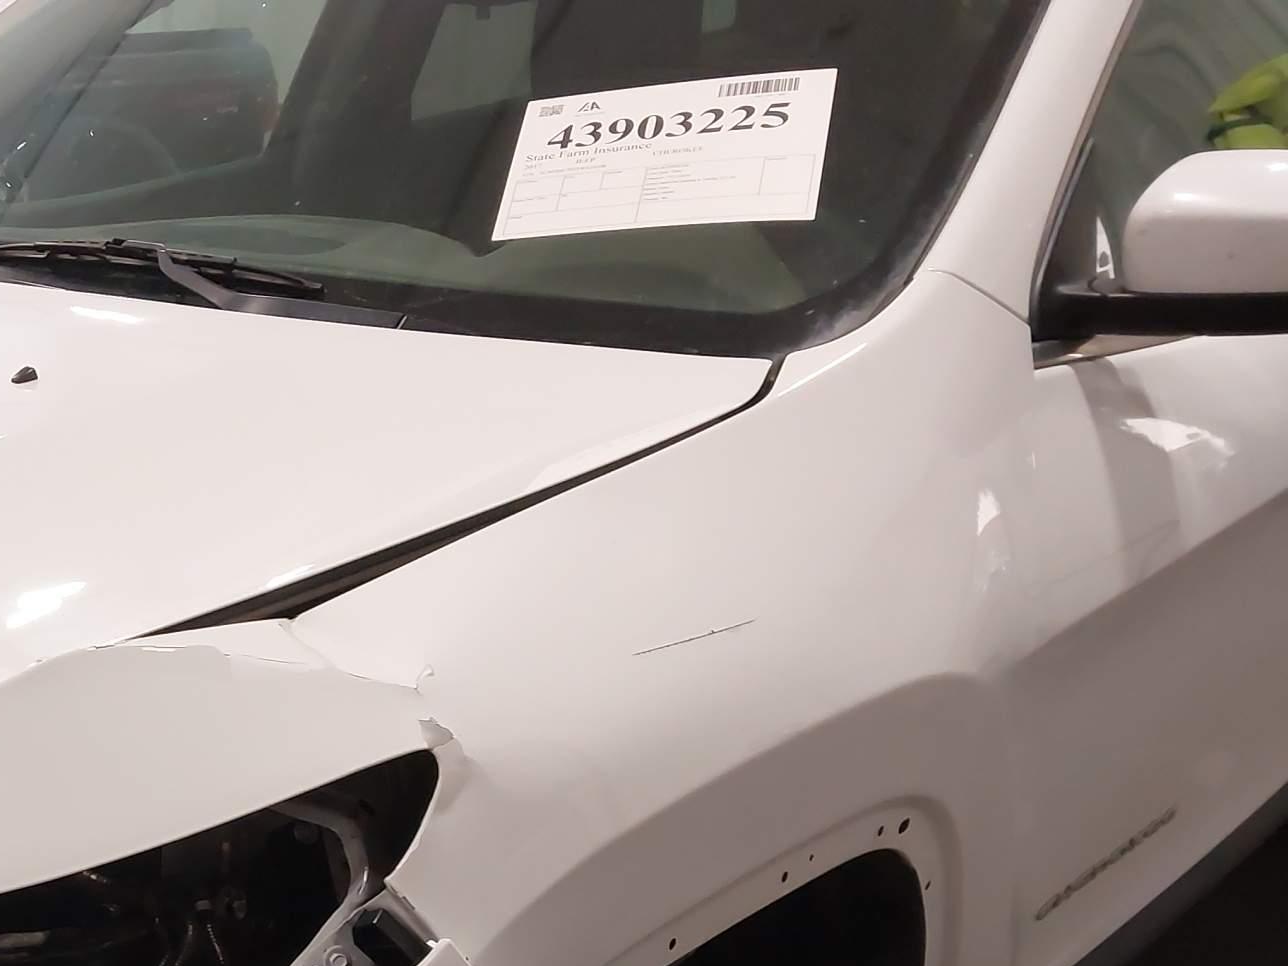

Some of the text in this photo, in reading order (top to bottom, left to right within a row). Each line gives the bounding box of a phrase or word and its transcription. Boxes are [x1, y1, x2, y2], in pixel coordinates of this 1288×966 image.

[547, 102, 792, 149] 43903225
[525, 143, 653, 163] State Farm Insurance
